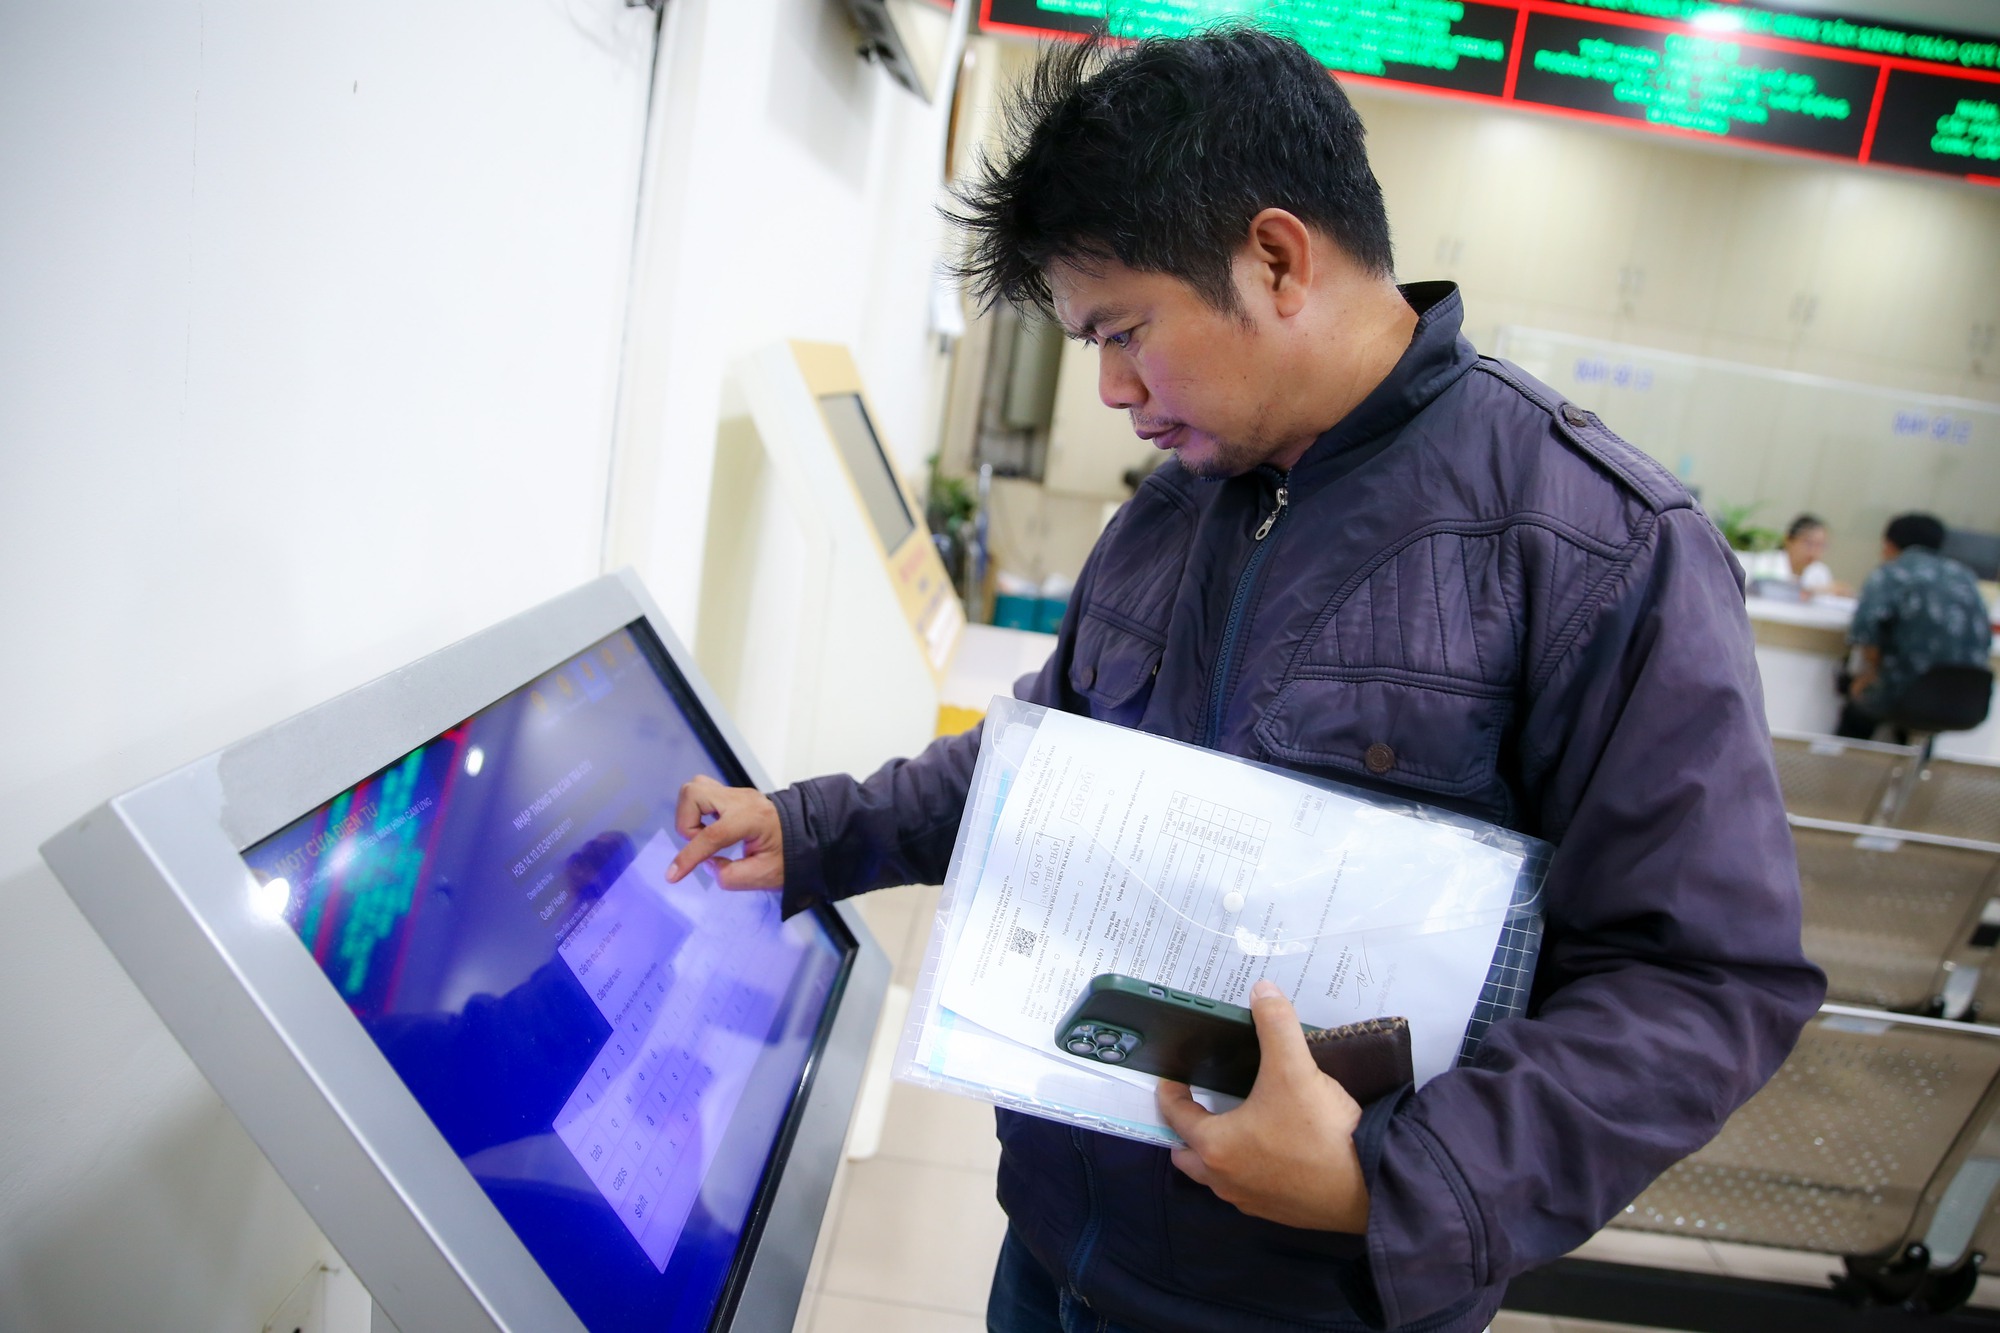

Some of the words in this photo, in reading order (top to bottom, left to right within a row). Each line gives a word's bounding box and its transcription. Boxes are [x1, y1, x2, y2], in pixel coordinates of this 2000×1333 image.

[1067, 792, 1085, 817] CẤP
[1077, 769, 1094, 792] ĐỔI
[512, 809, 534, 831] NHẬP
[1046, 839, 1060, 864] CHẤP
[1027, 869, 1039, 886] HỒ
[1033, 853, 1043, 869] SƠ
